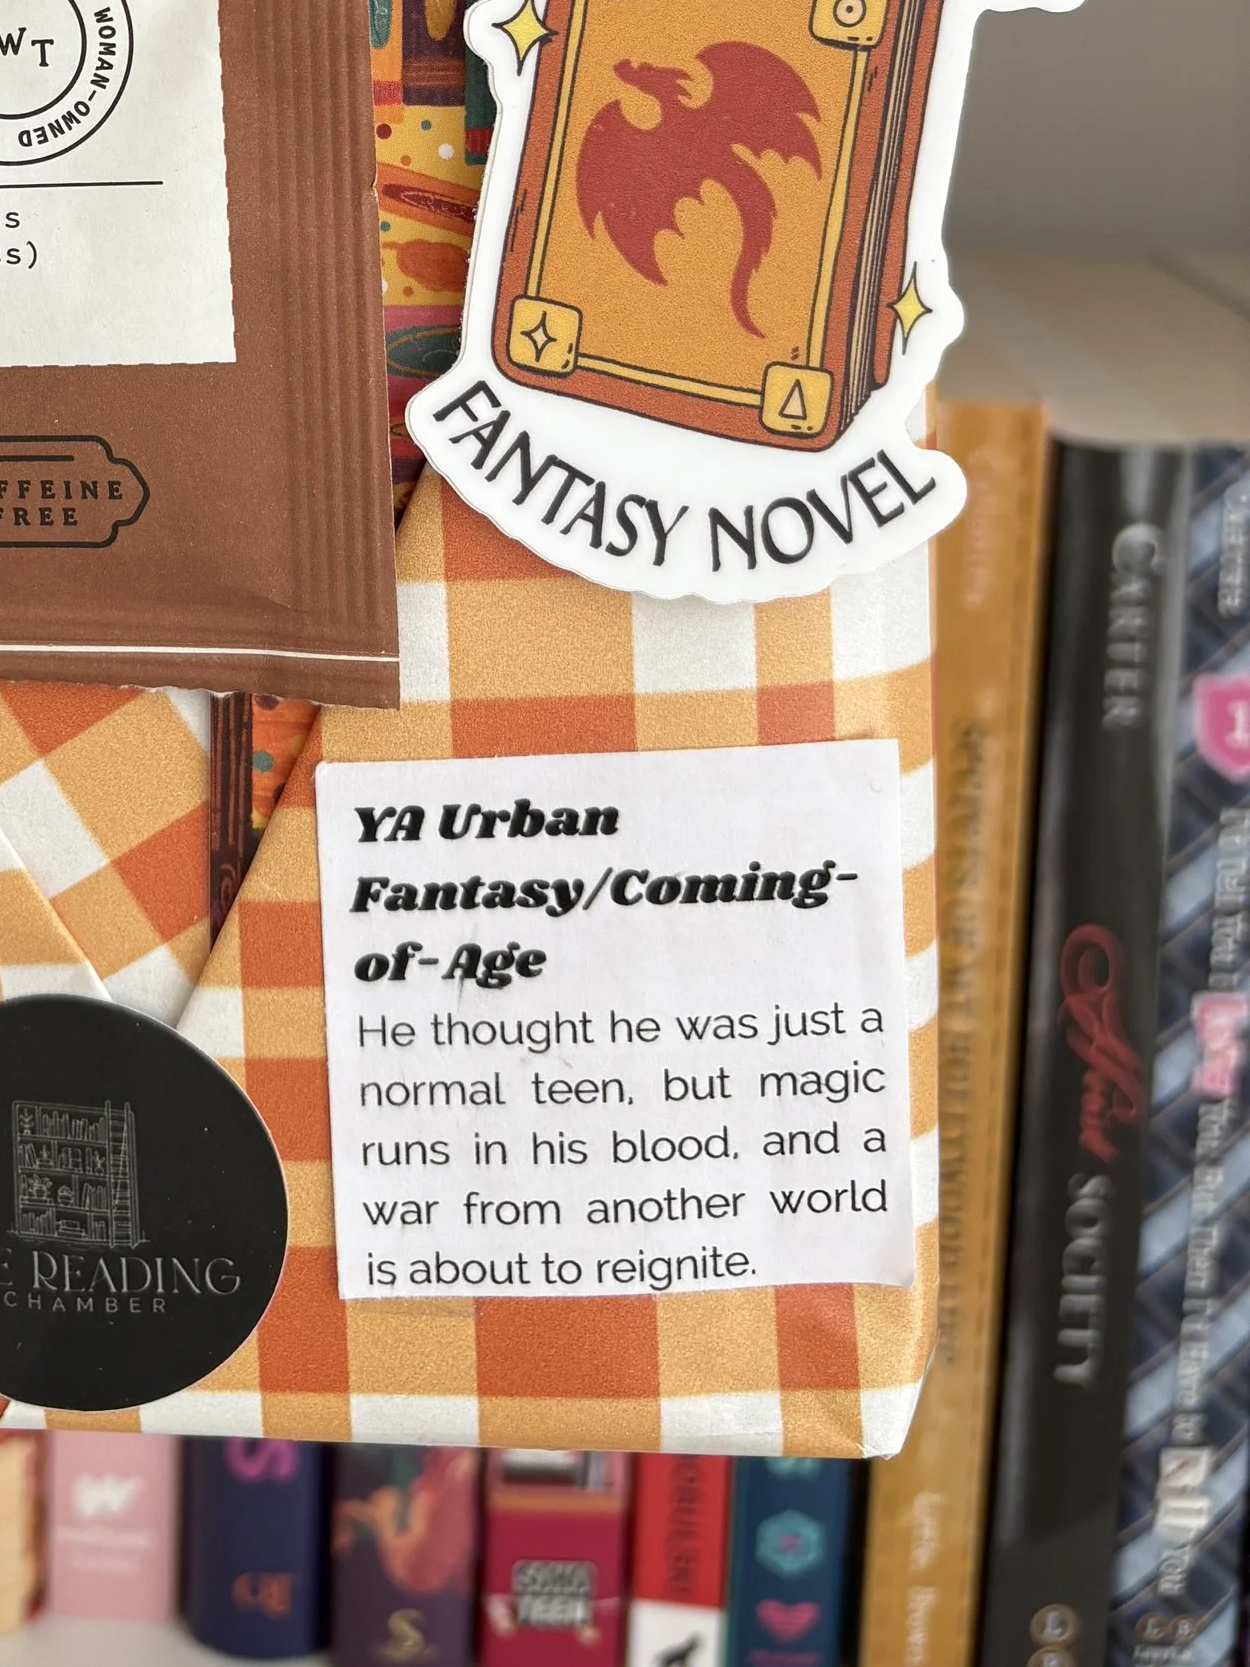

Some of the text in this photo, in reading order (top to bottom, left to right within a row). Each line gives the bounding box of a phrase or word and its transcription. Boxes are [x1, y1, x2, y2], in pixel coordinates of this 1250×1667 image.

[18, 6, 117, 147] WOMAN-OWNED
[433, 380, 689, 568] FANTASY
[707, 449, 938, 574] NOVEL
[1106, 524, 1165, 727] CARTER
[354, 799, 620, 843] YA Urban
[349, 860, 859, 916] Fantasy/Coming-
[353, 941, 547, 989] of-Age
[358, 1002, 884, 1054] He thought he was just a
[360, 1062, 886, 1107] normal teen, but magic
[362, 1121, 887, 1167] runs in his blood, and a
[362, 1180, 888, 1225] war from another world
[31, 1250, 241, 1295] READING
[367, 1246, 757, 1291] is about to reignite.
[1054, 1174, 1115, 1387] SOCIETY
[3, 1291, 167, 1314] CHAMBER
